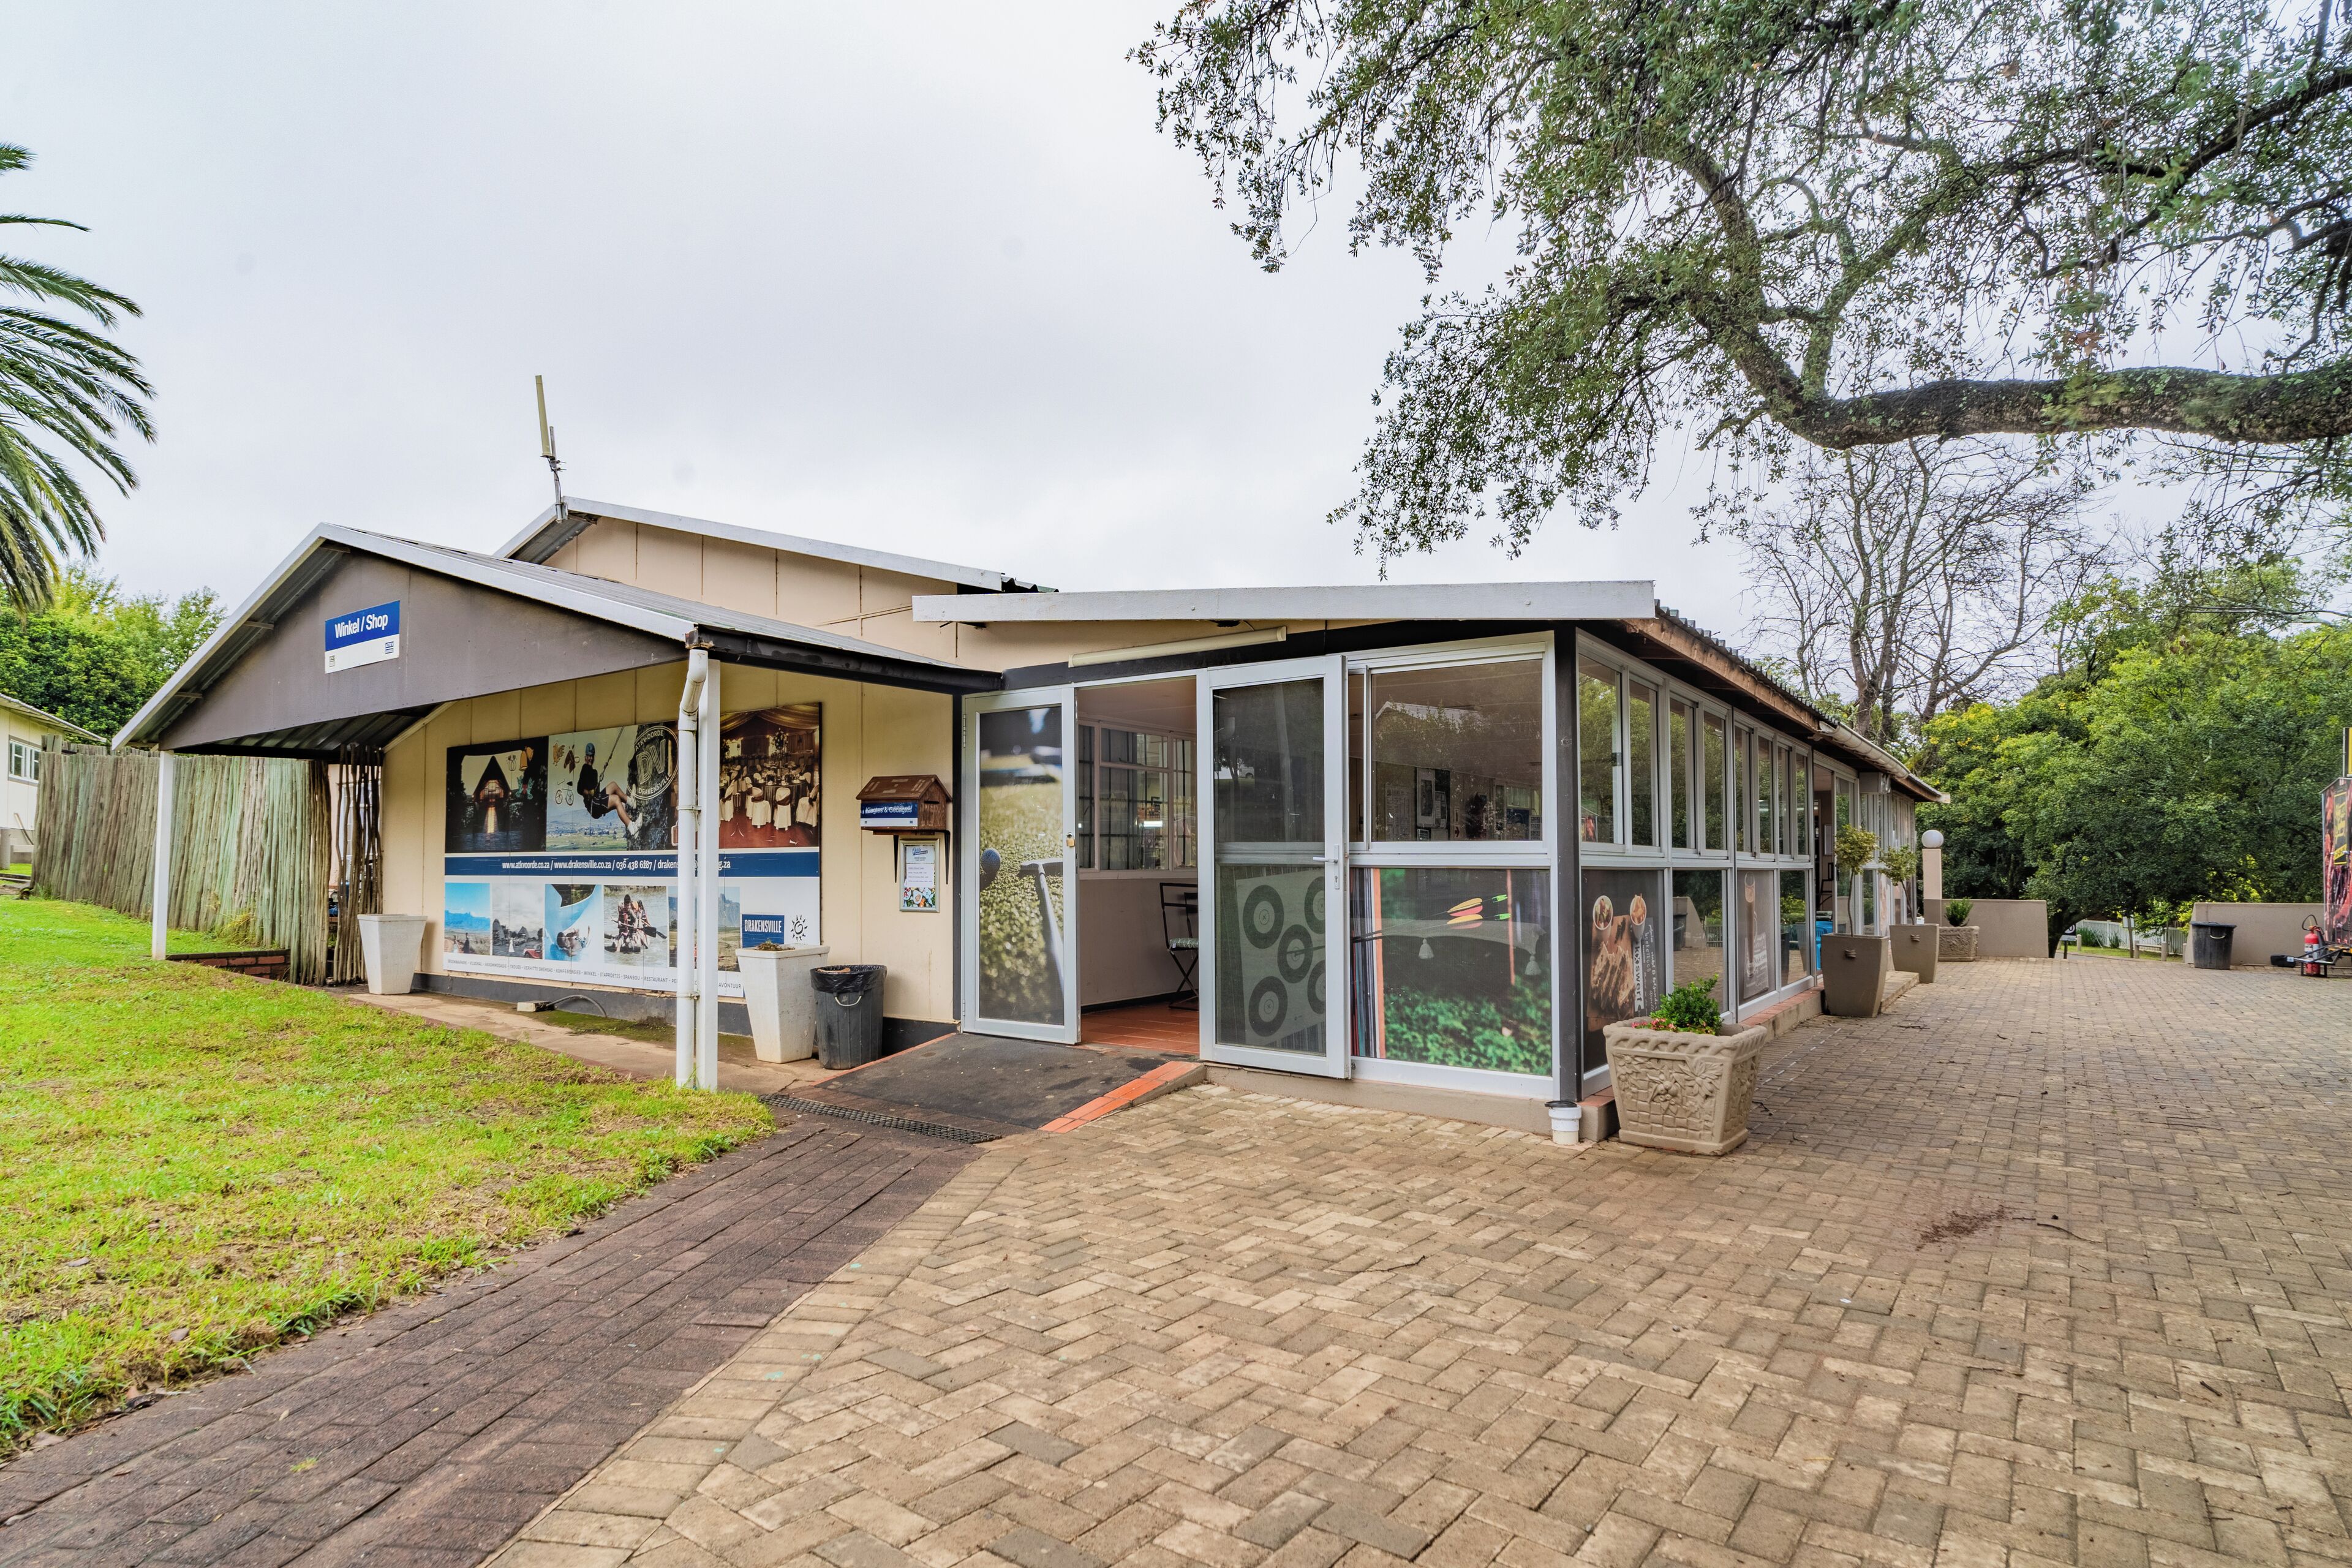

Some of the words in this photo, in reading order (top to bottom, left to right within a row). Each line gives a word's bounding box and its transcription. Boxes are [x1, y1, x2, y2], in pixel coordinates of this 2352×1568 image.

[335, 617, 360, 638] Winkel
[360, 616, 365, 632] /
[366, 614, 388, 630] Shop
[636, 739, 666, 785] DV
[502, 860, 550, 869] www.atkvoorde.co.za
[554, 859, 611, 869] www.drakensville.co.za
[627, 860, 638, 870] 438
[744, 919, 782, 933] DRAKENSVILLE
